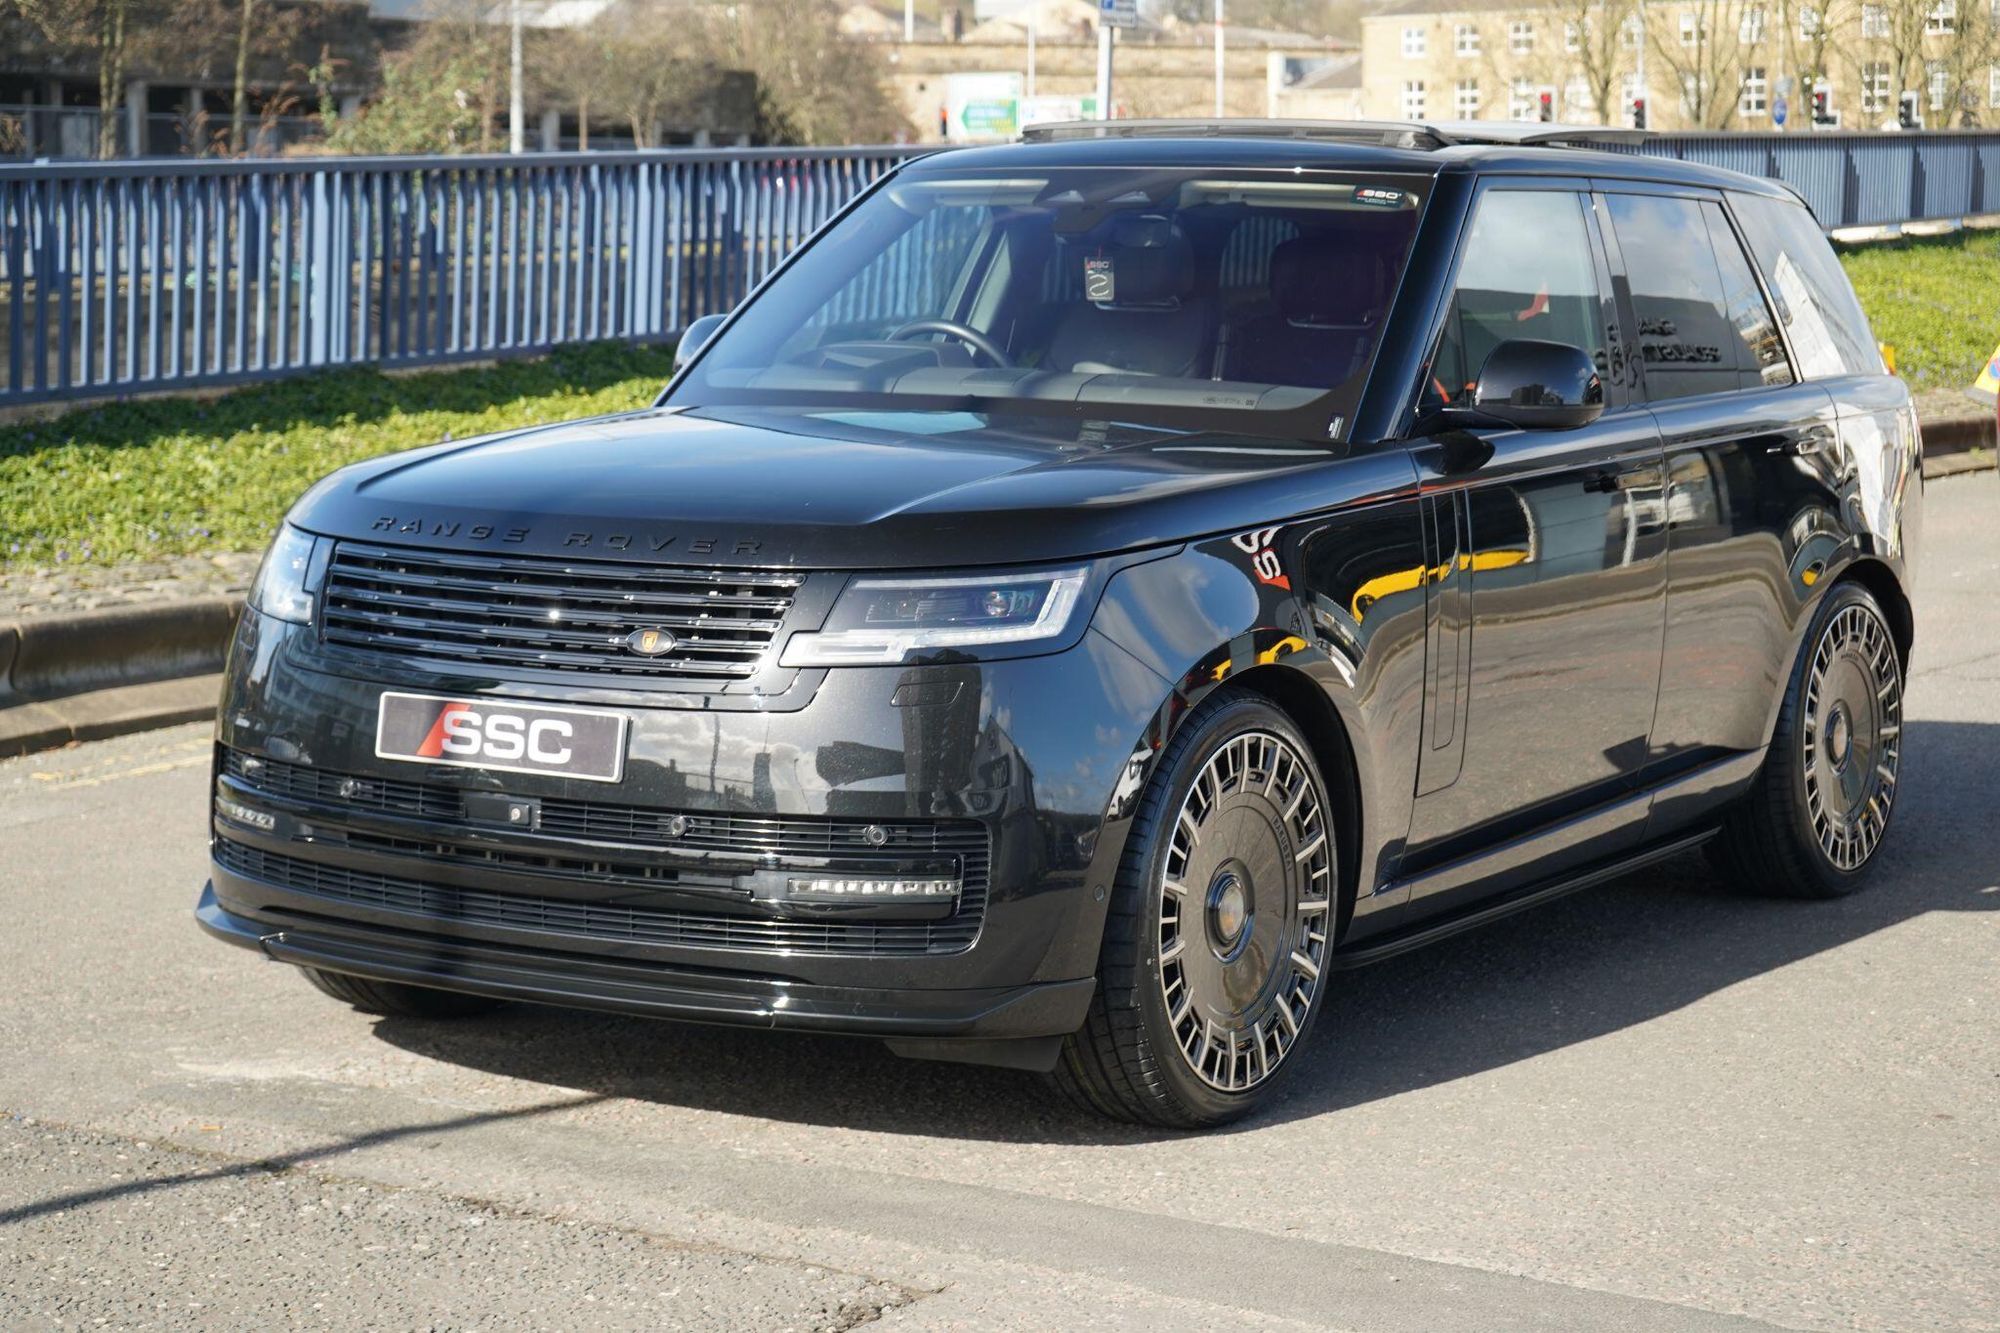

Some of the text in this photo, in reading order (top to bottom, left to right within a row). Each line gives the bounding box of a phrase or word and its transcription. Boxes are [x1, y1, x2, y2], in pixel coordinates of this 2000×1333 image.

[371, 516, 763, 556] RANGE ROVER
[441, 710, 573, 764] SSC
